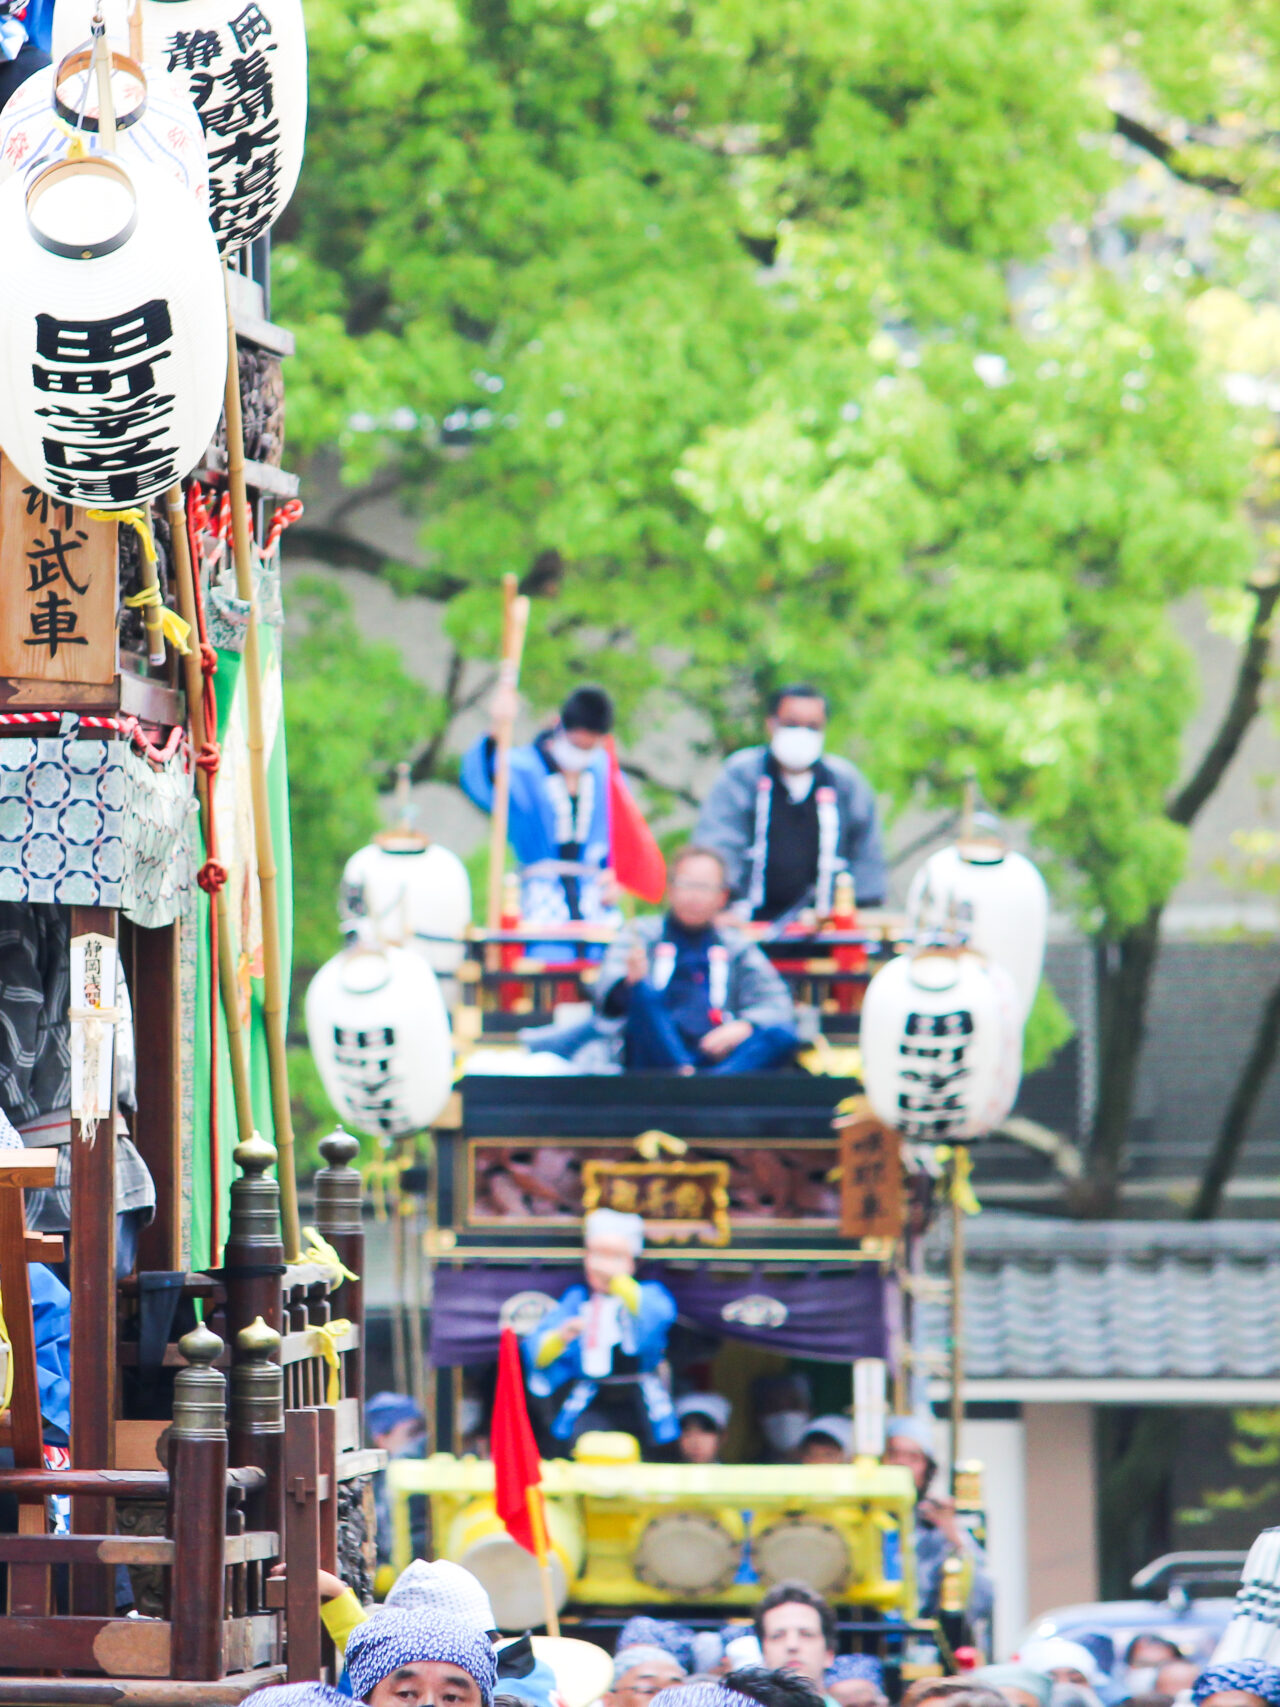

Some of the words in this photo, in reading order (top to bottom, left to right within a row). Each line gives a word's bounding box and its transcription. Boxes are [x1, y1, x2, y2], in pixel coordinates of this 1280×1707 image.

[32, 298, 181, 502] 田町学区連
